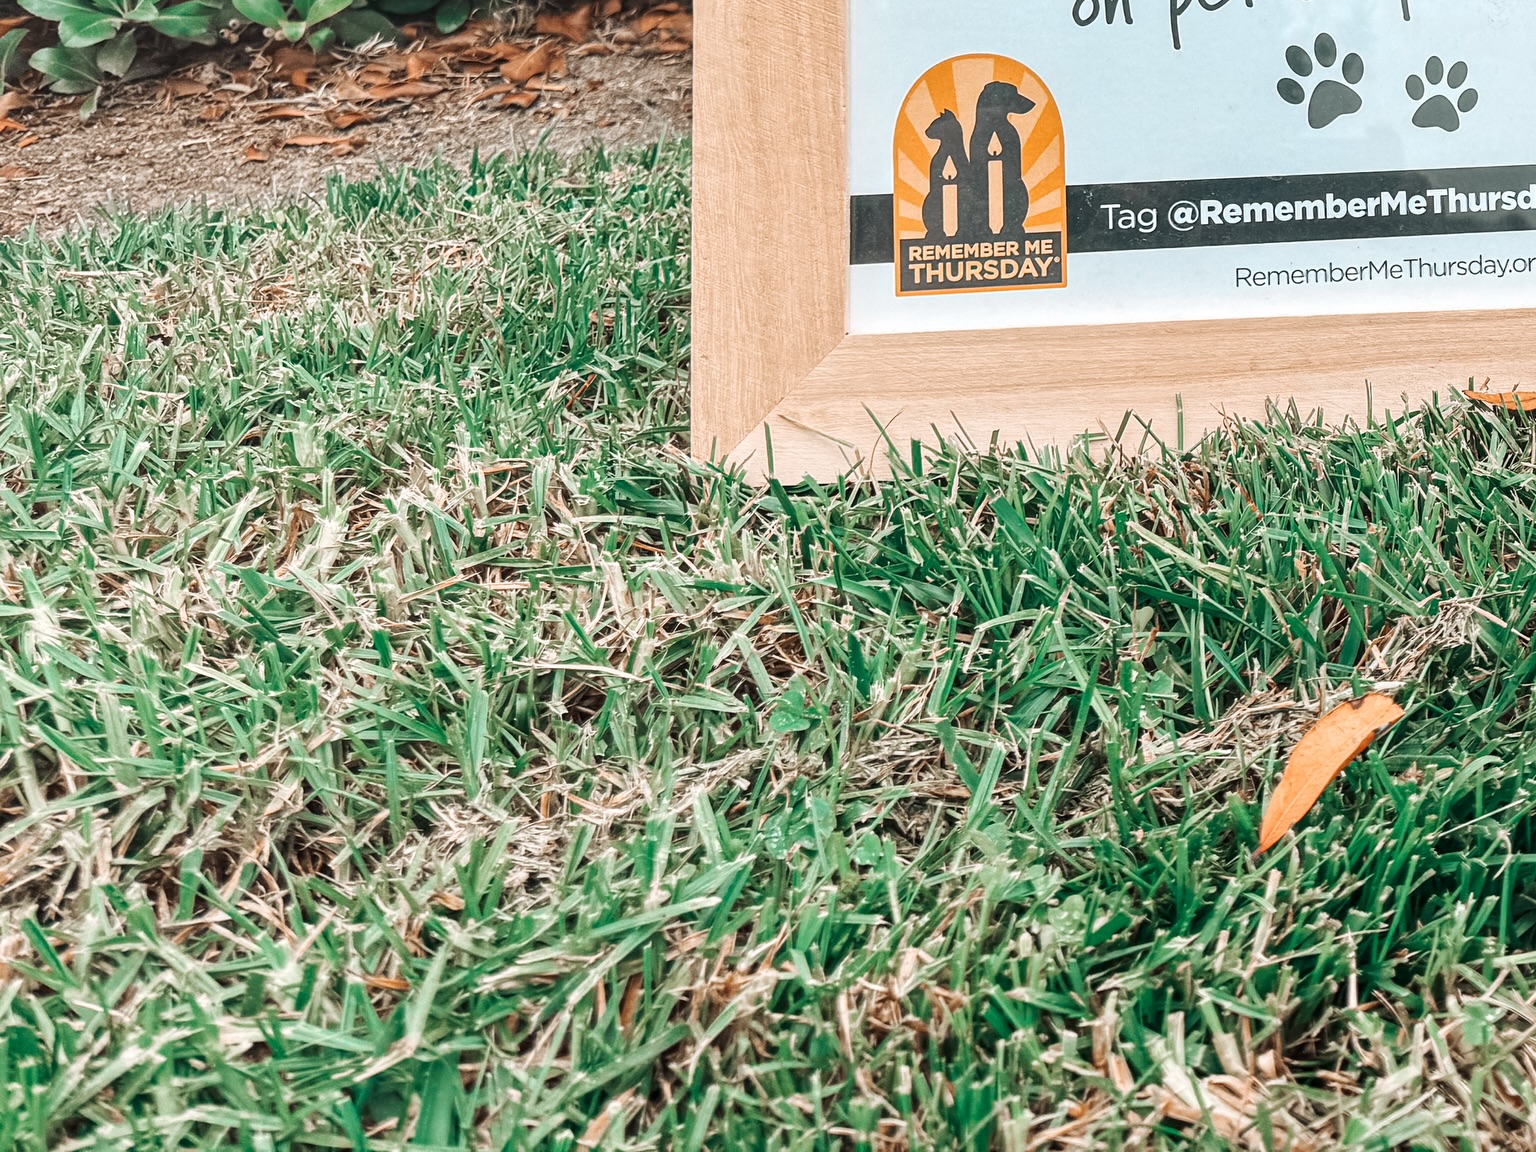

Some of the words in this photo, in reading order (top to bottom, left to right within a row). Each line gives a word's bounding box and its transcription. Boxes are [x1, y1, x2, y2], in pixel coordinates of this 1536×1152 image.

[1099, 203, 1159, 232] Tag
[908, 240, 1020, 262] REMEMBER
[1024, 239, 1054, 255] ME
